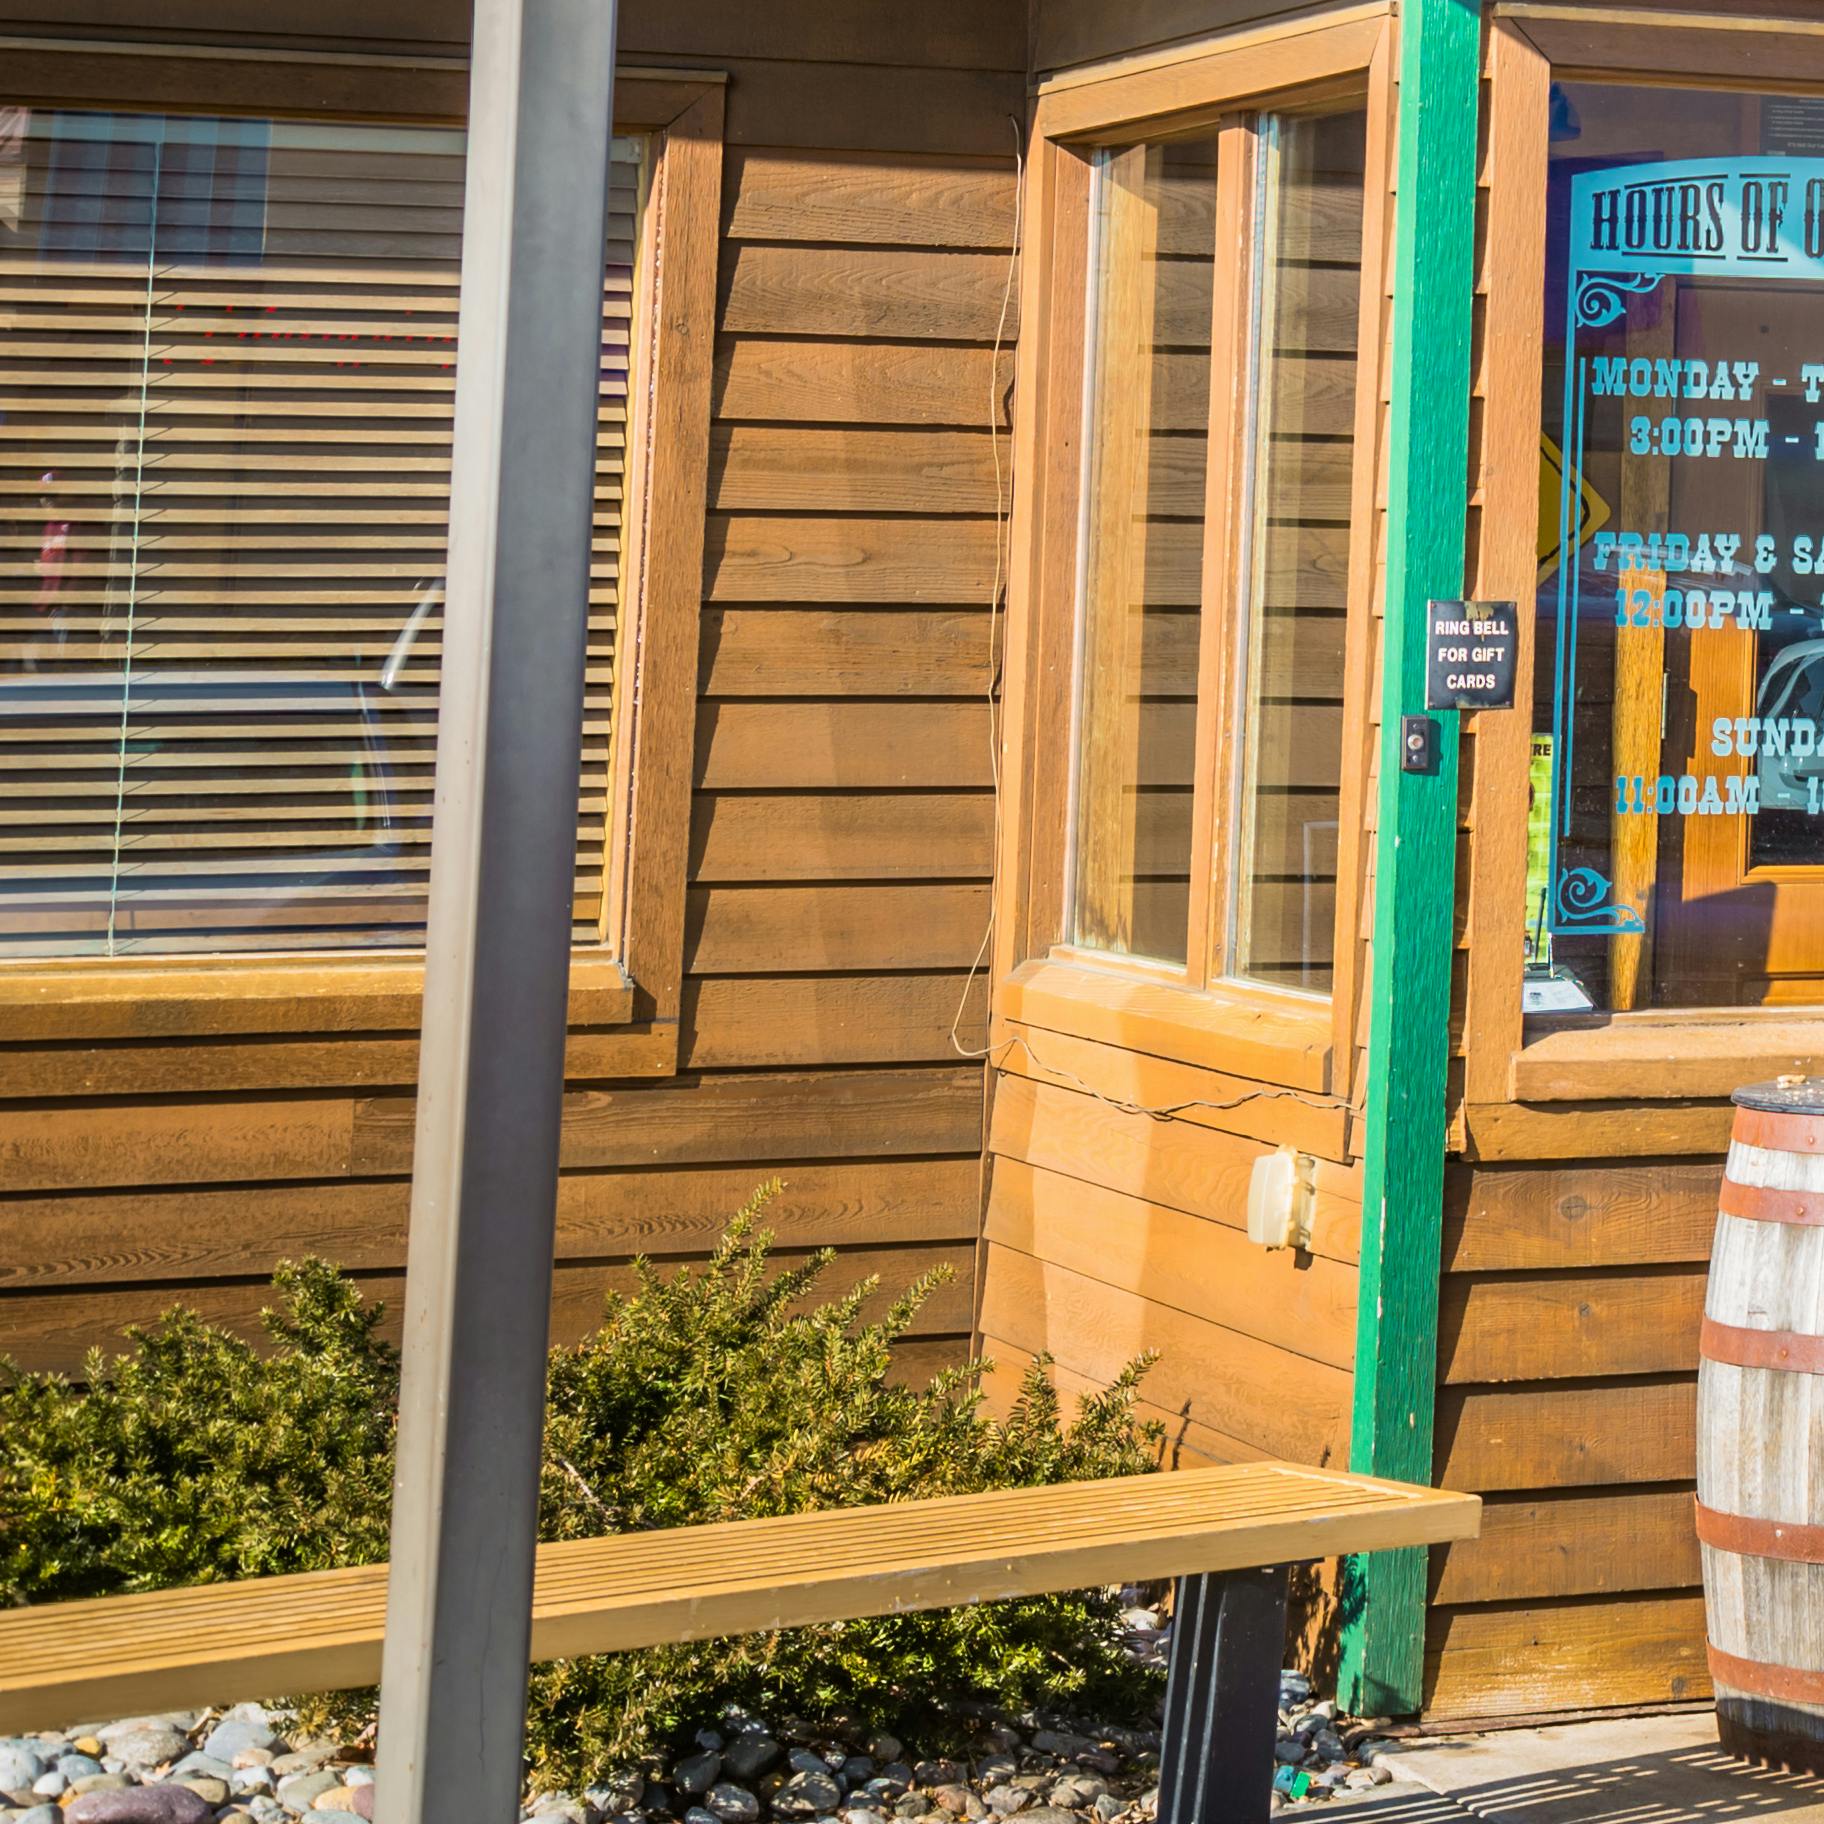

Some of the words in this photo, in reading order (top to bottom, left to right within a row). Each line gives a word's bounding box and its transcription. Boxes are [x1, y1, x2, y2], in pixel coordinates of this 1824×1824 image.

[1590, 181, 1725, 252] HOURS
[1739, 180, 1788, 254] OF
[1591, 357, 1760, 402] MONDAY
[1629, 416, 1770, 460] 3:00PM
[1592, 531, 1740, 574] FRIDAY
[1754, 534, 1777, 575] &
[1435, 621, 1469, 636] RING
[1473, 621, 1509, 636] BELL
[1614, 590, 1774, 632] 12:00PM
[1438, 647, 1467, 663] FOR
[1471, 647, 1505, 663] GIFT
[1446, 674, 1496, 689] CARDS
[1531, 743, 1552, 756] RE
[1614, 774, 1761, 816] 11:00AM
